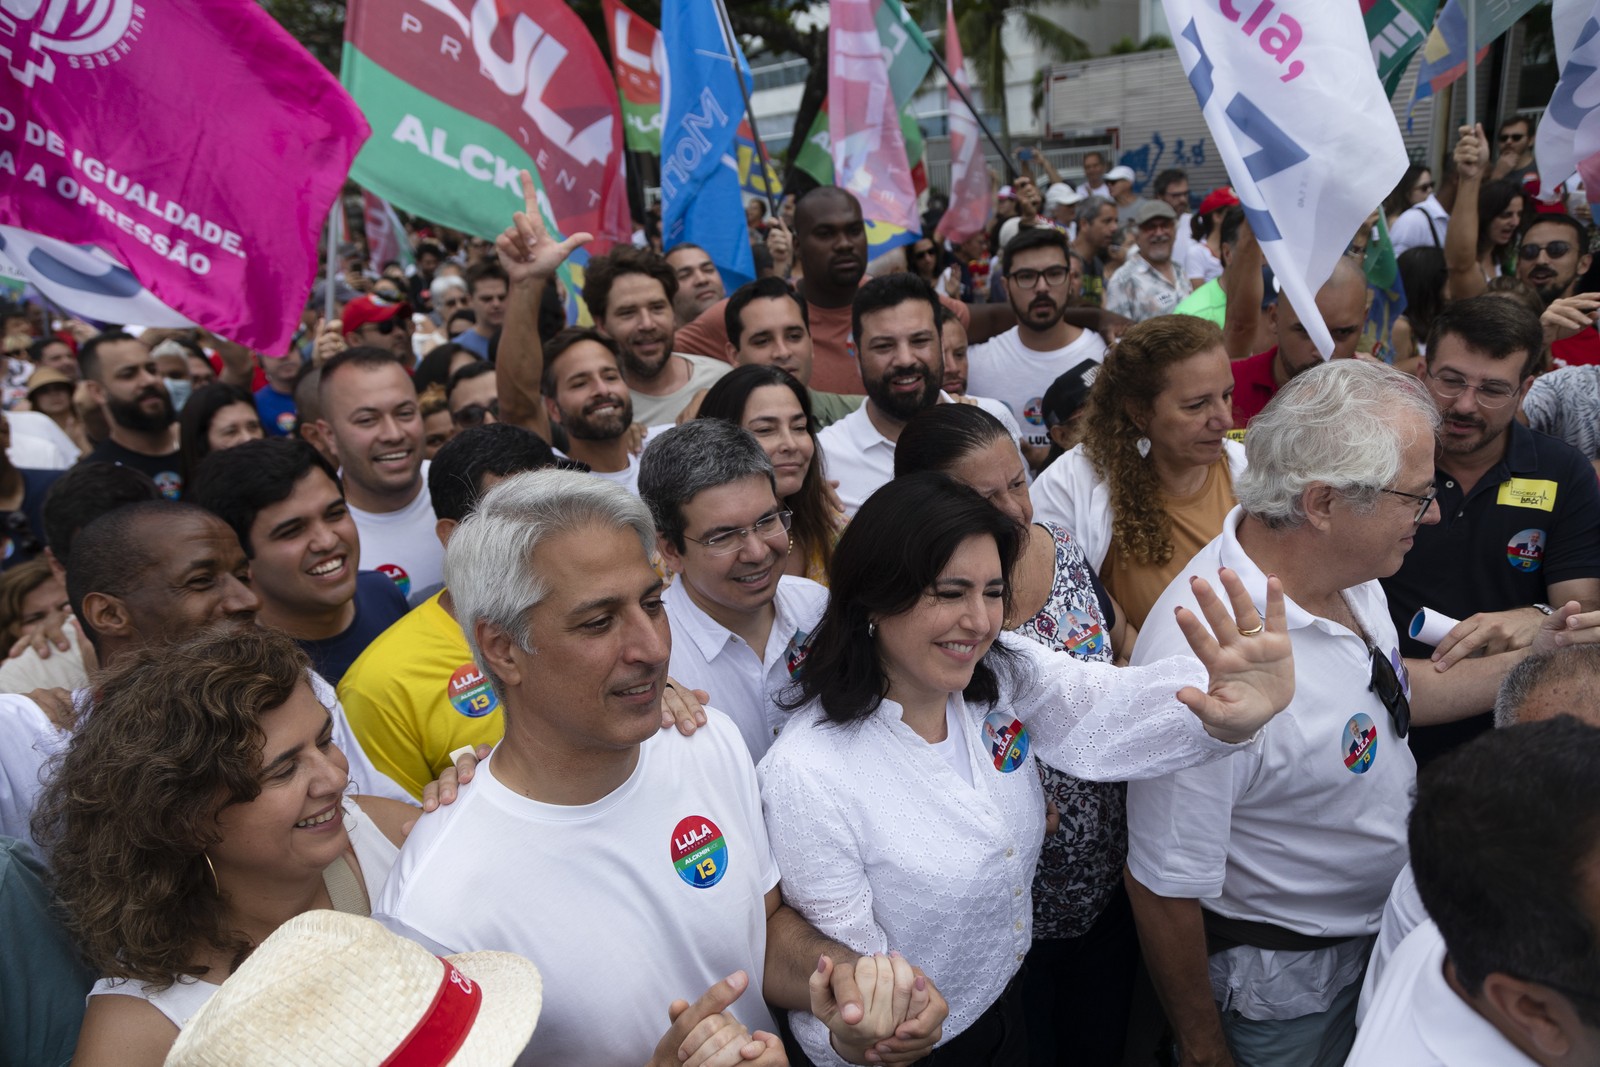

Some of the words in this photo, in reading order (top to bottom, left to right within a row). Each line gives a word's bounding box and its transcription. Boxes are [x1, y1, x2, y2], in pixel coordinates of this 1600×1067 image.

[67, 3, 146, 69] MULHERES
[25, 120, 66, 157] DE
[73, 148, 247, 259] IGUALDADE.
[24, 163, 46, 188] A
[56, 175, 211, 275] OPRESSÃO
[1520, 549, 1538, 557] LULA
[1075, 629, 1092, 642] LULA
[470, 694, 490, 711] 13
[997, 733, 1013, 757] LULA
[1355, 737, 1370, 757] LULA
[675, 823, 713, 851] LULA
[685, 846, 711, 865] ALCKMIN
[696, 857, 717, 880] 13
